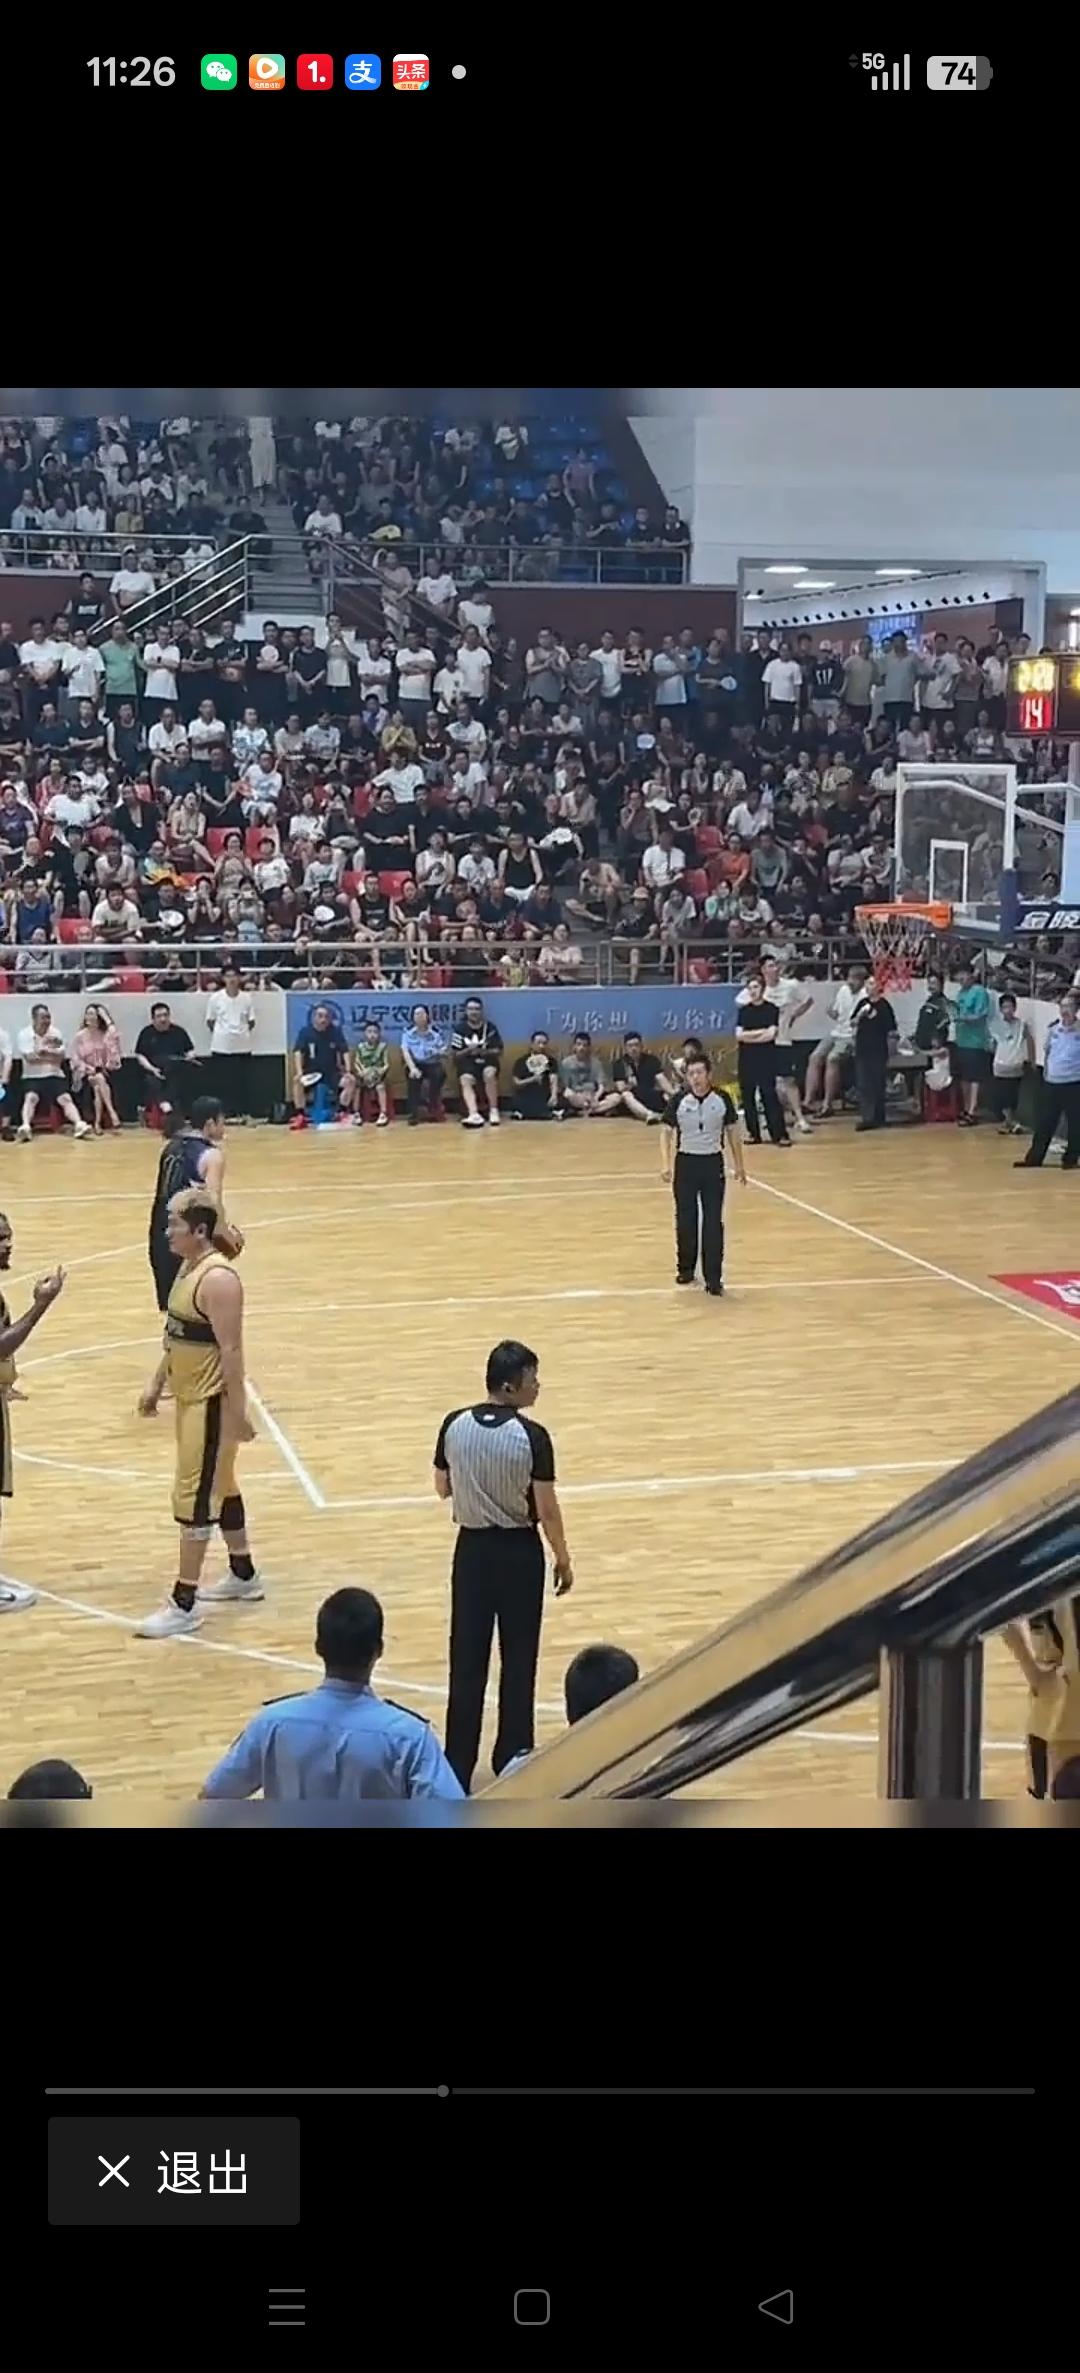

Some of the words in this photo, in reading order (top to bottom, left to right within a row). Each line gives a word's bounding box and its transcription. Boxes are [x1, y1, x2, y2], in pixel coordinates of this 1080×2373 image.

[1025, 696, 1043, 729] 14
[352, 1003, 467, 1023] 辽宁农银行
